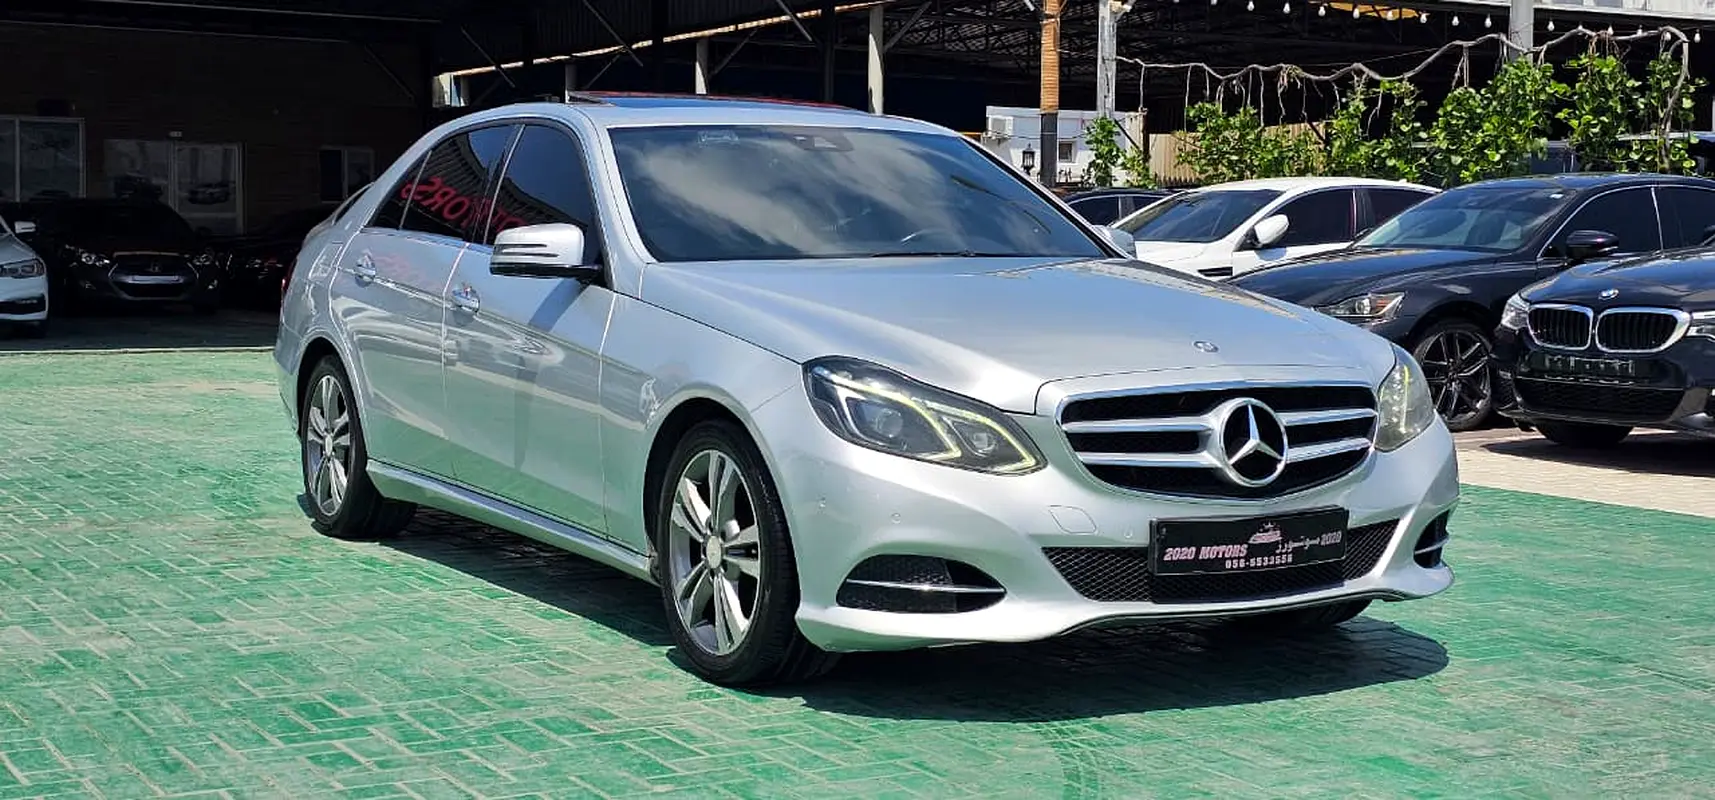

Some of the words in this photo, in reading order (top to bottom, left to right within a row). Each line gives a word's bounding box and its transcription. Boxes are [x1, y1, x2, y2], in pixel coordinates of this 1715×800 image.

[1320, 530, 1342, 546] 2020
[1163, 547, 1197, 561] 2020
[1199, 544, 1249, 560] MOTORS
